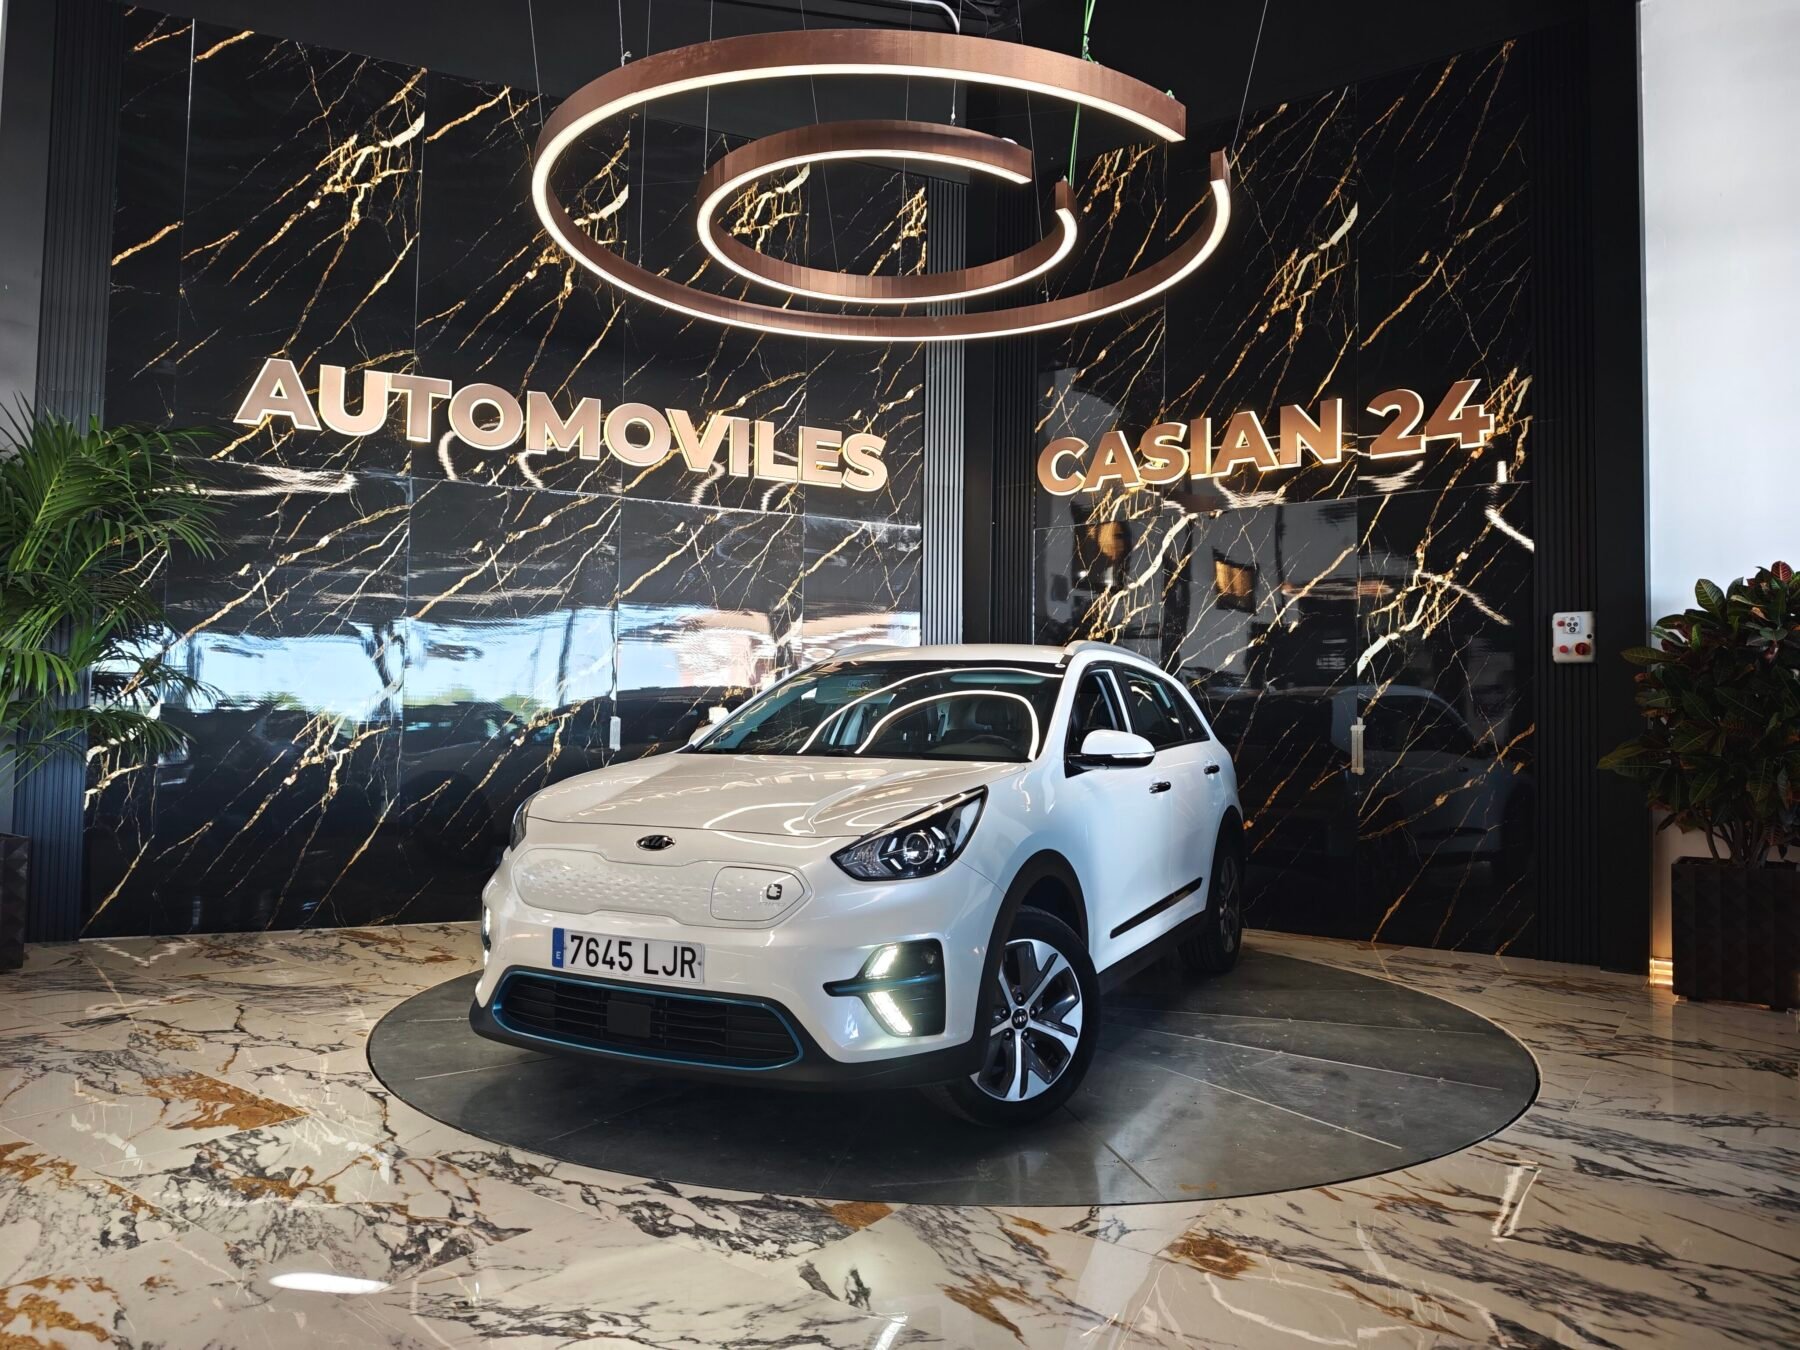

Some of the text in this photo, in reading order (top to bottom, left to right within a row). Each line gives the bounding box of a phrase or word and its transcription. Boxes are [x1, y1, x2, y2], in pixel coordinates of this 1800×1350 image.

[233, 358, 888, 492] AUTOMOVILES
[1036, 378, 1496, 496] CASIAN 24
[555, 951, 562, 960] E
[570, 935, 697, 979] 7645 LJR
